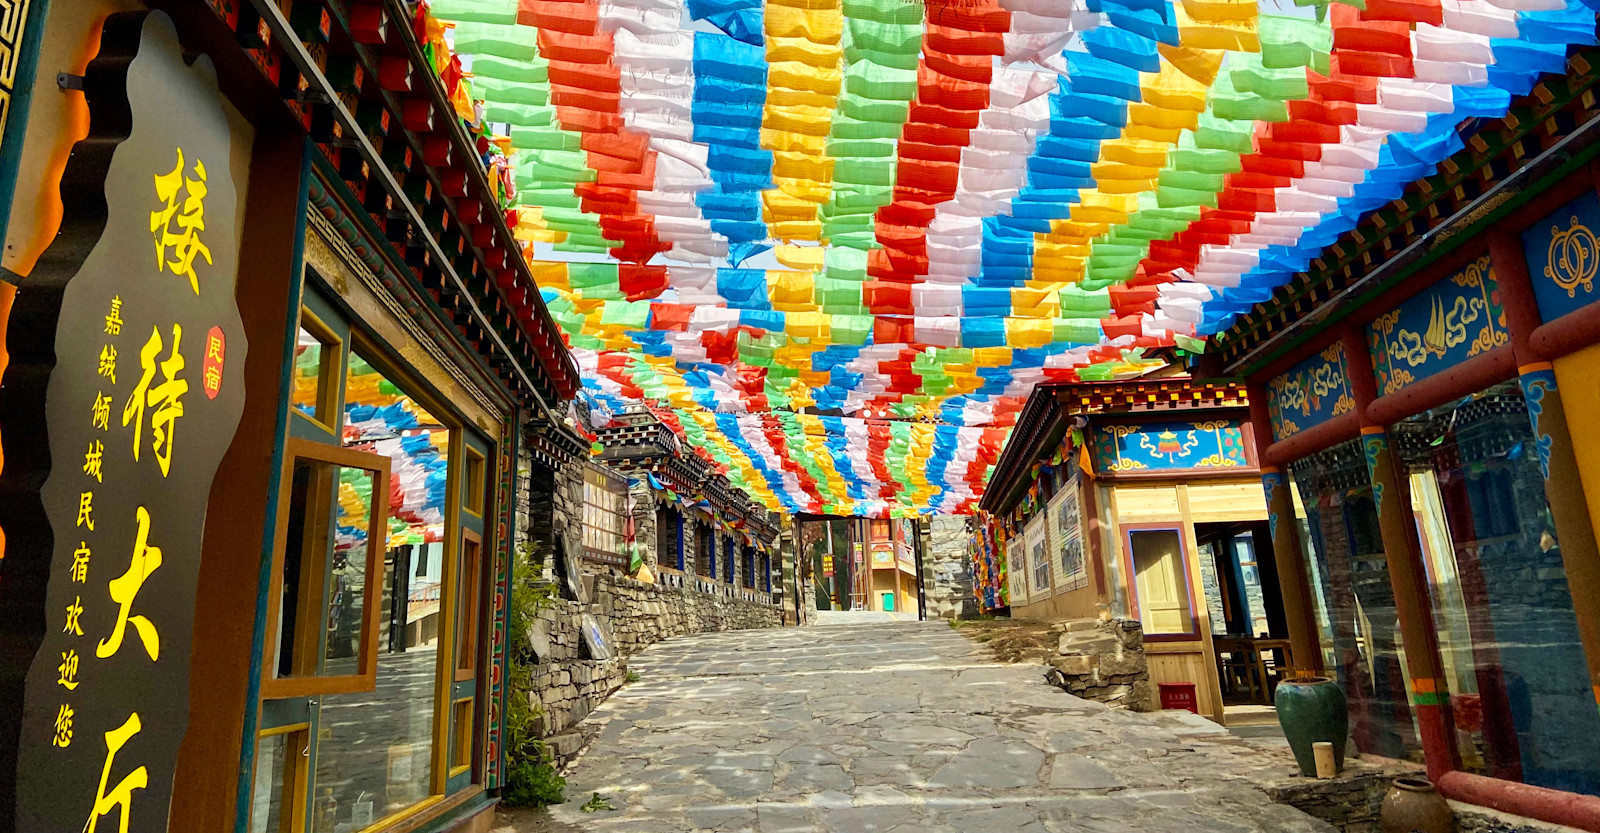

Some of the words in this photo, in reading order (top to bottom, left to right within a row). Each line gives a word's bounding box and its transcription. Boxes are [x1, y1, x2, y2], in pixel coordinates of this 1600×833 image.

[53, 295, 124, 748] 嘉绒倾城民宿欢迎您
[83, 147, 213, 833] 接待大厅
[206, 336, 223, 391] 民宿
